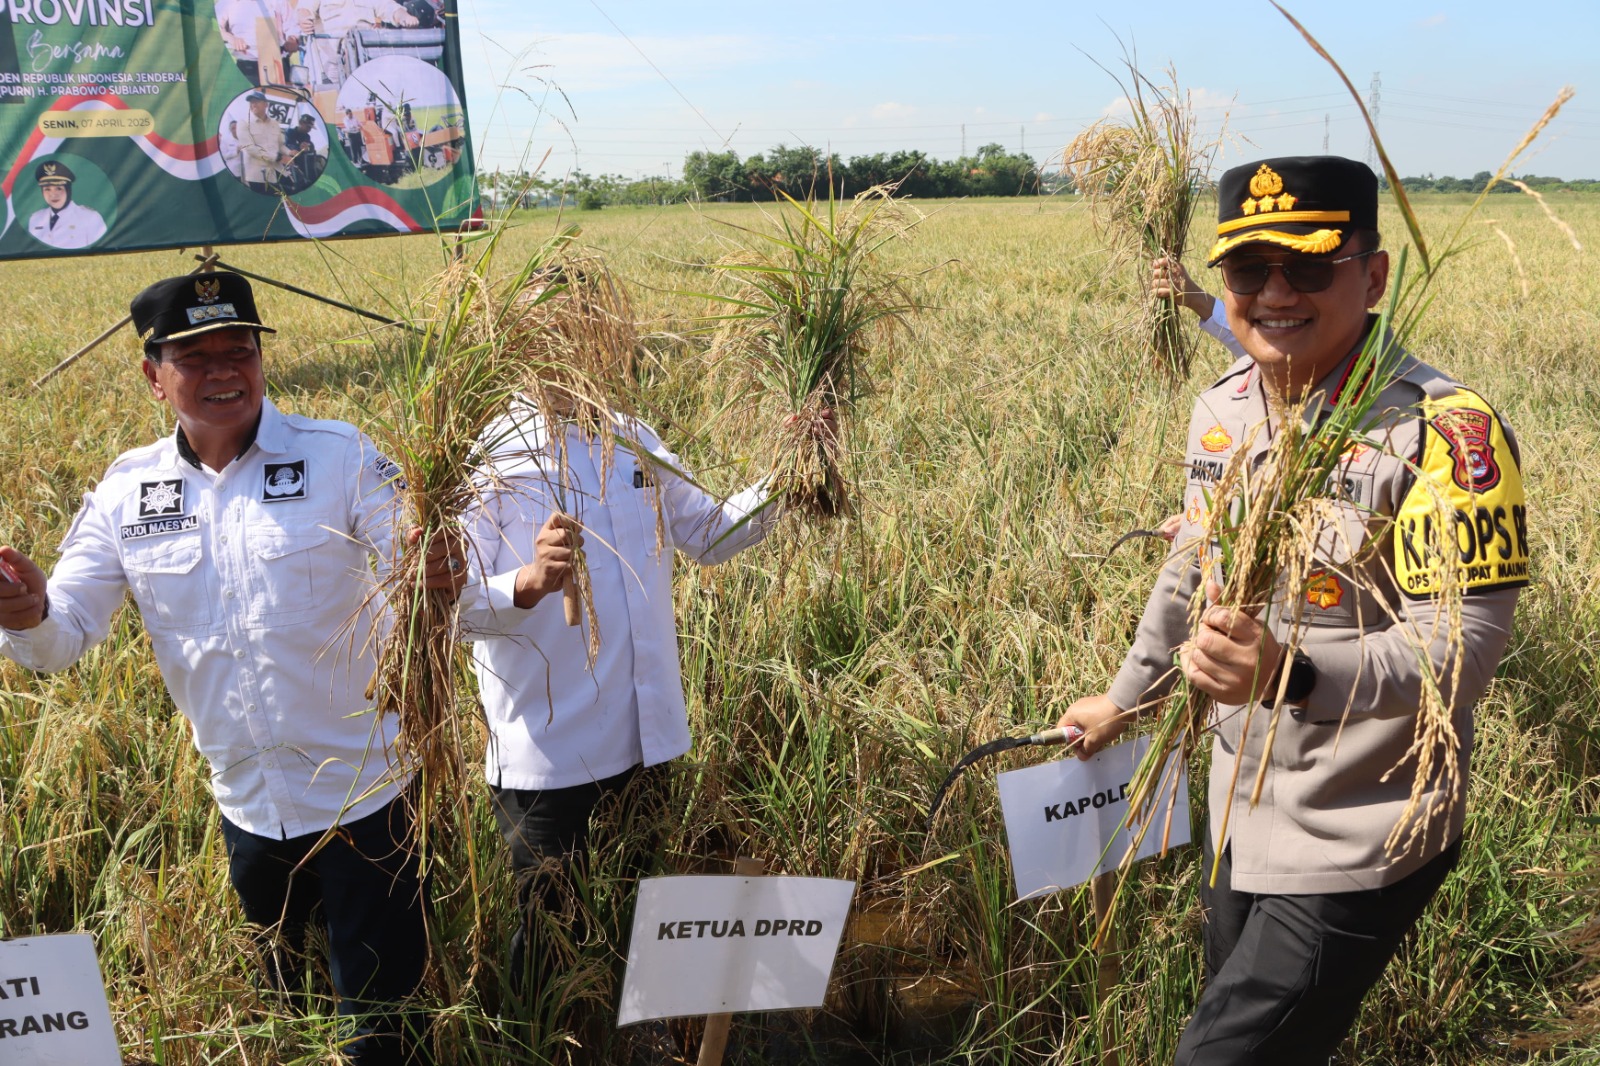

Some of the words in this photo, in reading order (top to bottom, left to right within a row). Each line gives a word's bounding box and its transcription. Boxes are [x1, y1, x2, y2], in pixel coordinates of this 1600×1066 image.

[26, 29, 125, 72] Bersama
[22, 73, 76, 84] REPUBLIK
[78, 73, 133, 84] INDONESIA
[136, 72, 188, 83] JENDERAL
[38, 86, 49, 96] H.
[51, 85, 107, 96] PRABOWO
[109, 85, 160, 95] SUBIANTO
[43, 120, 79, 129] SENIN,
[81, 119, 93, 128] 07
[95, 118, 125, 128] APRIL
[128, 118, 150, 127] 2025
[121, 524, 147, 538] RUDI
[149, 516, 197, 534] MAESYAL
[1407, 573, 1430, 590] OPS
[657, 920, 746, 940] KETUA
[754, 919, 823, 937] DPRD
[0, 1011, 89, 1039] RANG
